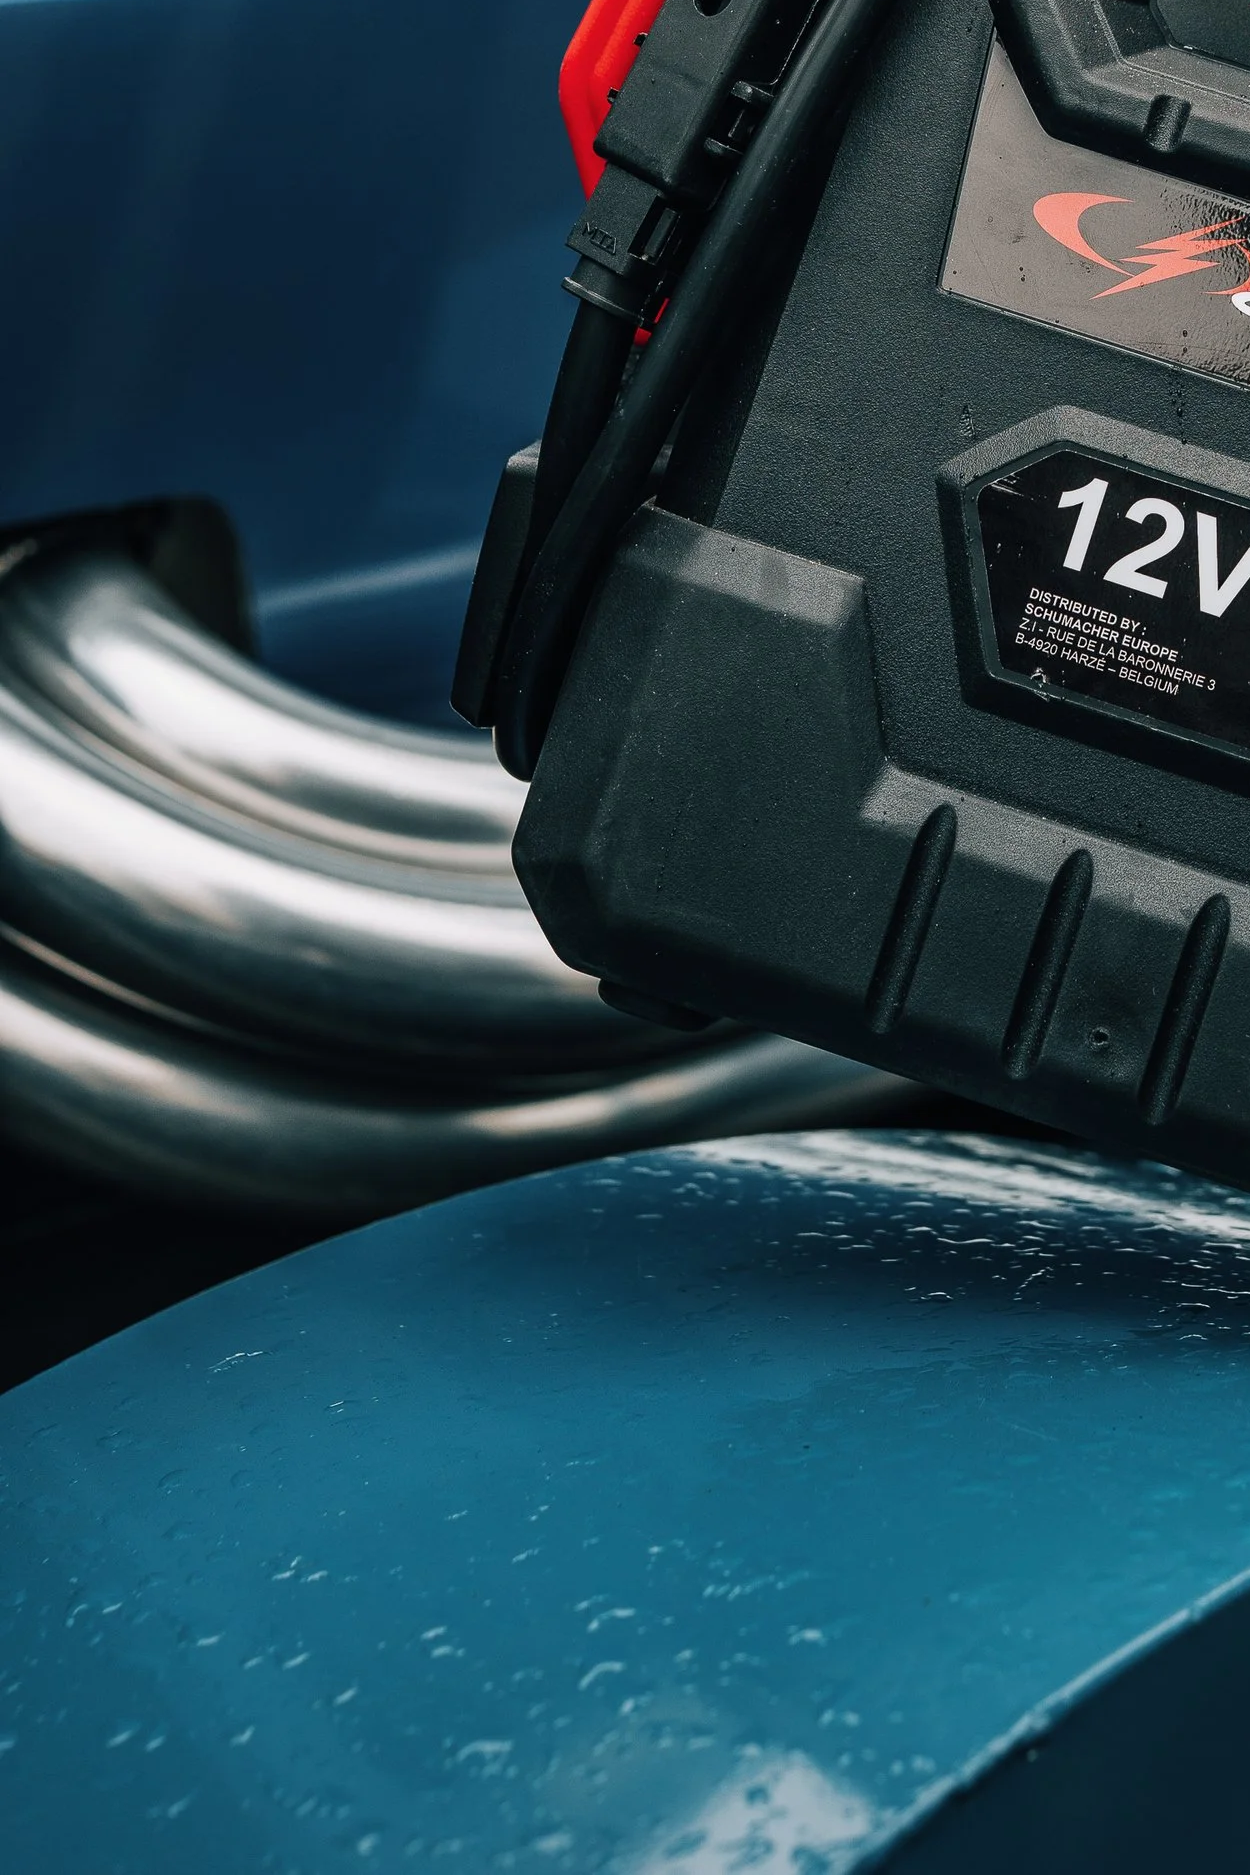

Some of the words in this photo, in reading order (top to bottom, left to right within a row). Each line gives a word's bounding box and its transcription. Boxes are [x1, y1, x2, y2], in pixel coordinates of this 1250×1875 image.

[1024, 603, 1119, 643] SCHUMACHER
[1122, 634, 1179, 662] EUROPE
[1029, 587, 1118, 627] DISTRIBUTED
[1121, 618, 1141, 632] BY
[1015, 632, 1058, 656] B-4920
[1060, 648, 1106, 672] HARZÉ
[1119, 666, 1180, 696] BELGIUM
[1019, 617, 1036, 632] Z.I
[1046, 626, 1076, 645] RUE
[1077, 637, 1098, 652] DE
[1099, 643, 1115, 659] LA
[1117, 649, 1206, 687] BARONNERIE
[1207, 679, 1216, 691] 3
